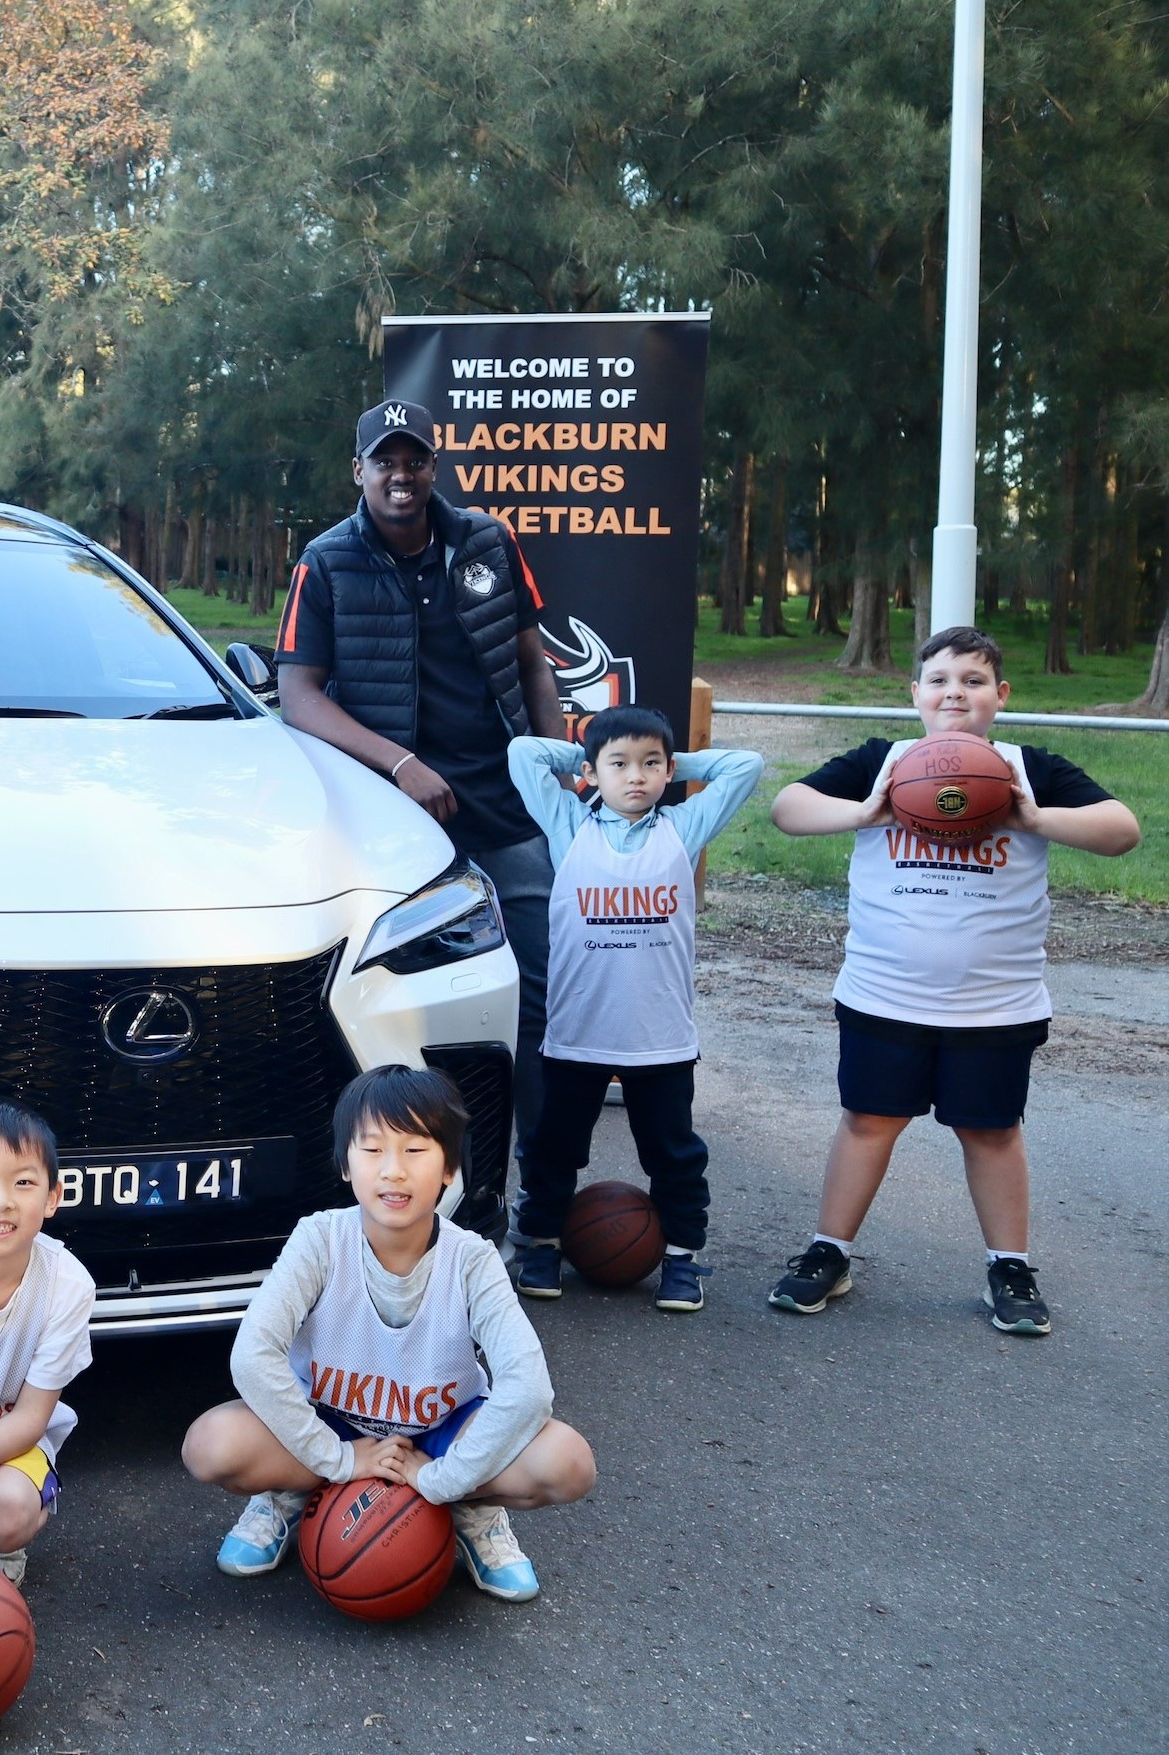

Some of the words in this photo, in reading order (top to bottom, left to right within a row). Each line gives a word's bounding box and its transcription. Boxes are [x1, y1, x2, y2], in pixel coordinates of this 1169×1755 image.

[451, 357, 590, 379] WELCOME
[597, 357, 635, 378] TO
[448, 389, 503, 410] THE
[511, 389, 592, 409] HOME
[600, 388, 638, 409] OF
[454, 464, 625, 493] VIKINGS
[466, 505, 671, 535] KETBALL
[925, 756, 962, 776] HOS
[922, 873, 956, 881] POWERED
[576, 884, 678, 917] VIKINGS
[905, 887, 948, 896] LEXUS
[963, 891, 997, 900] BLACKBURN
[58, 1165, 140, 1208] BTQ
[177, 1158, 242, 1201] 141
[311, 1361, 457, 1425] VIKINGS
[341, 1480, 394, 1541] JE
[381, 1502, 427, 1548] CHRISTIAN
